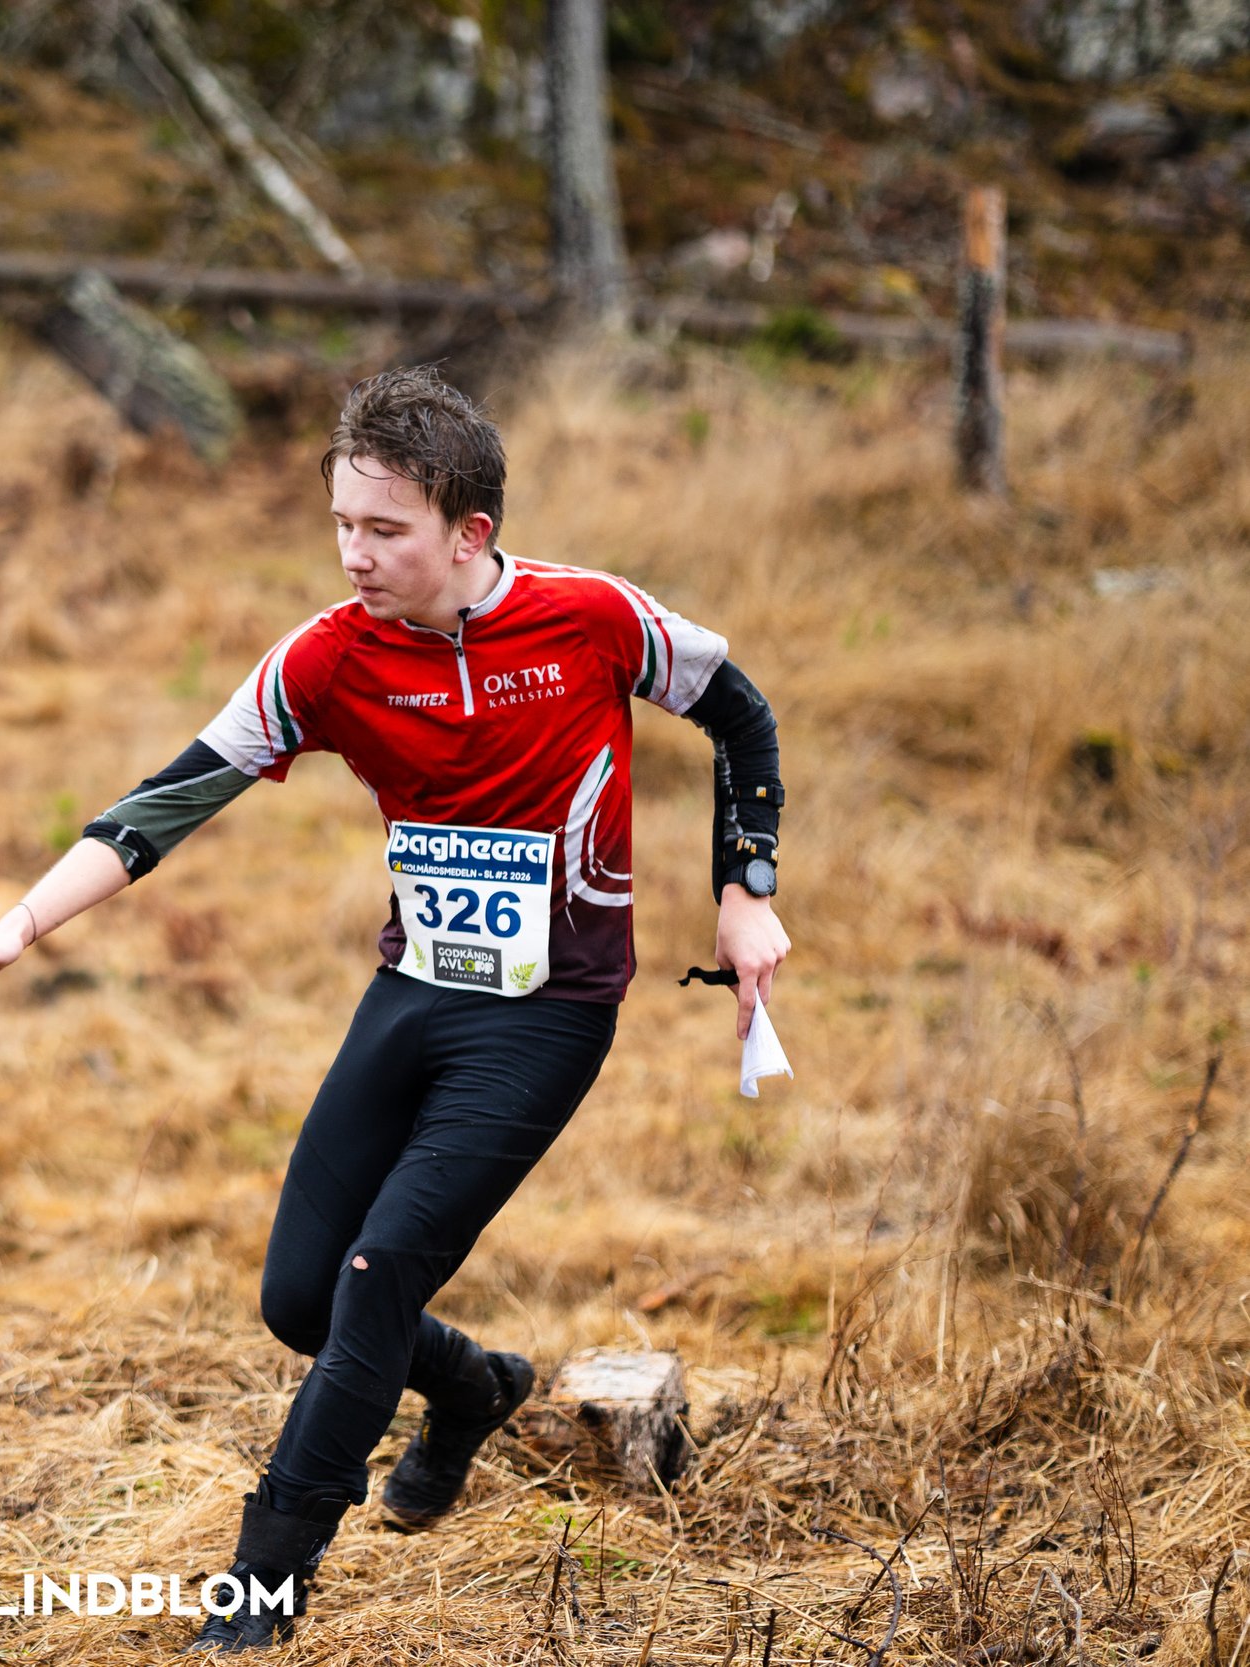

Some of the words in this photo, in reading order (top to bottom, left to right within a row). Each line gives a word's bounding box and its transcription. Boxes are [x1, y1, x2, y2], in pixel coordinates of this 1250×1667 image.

[483, 672, 518, 694] OK
[520, 663, 562, 686] TYR
[387, 692, 449, 708] TRIMTEX
[489, 685, 565, 708] KARLSTAD
[391, 828, 548, 864] bagheera
[402, 863, 477, 878] KOLMÅRDSMEDELN
[483, 871, 494, 880] SL
[495, 872, 508, 881] #2
[509, 872, 532, 882] 2026
[414, 884, 521, 938] 326
[438, 947, 495, 963] GODKÄNDA
